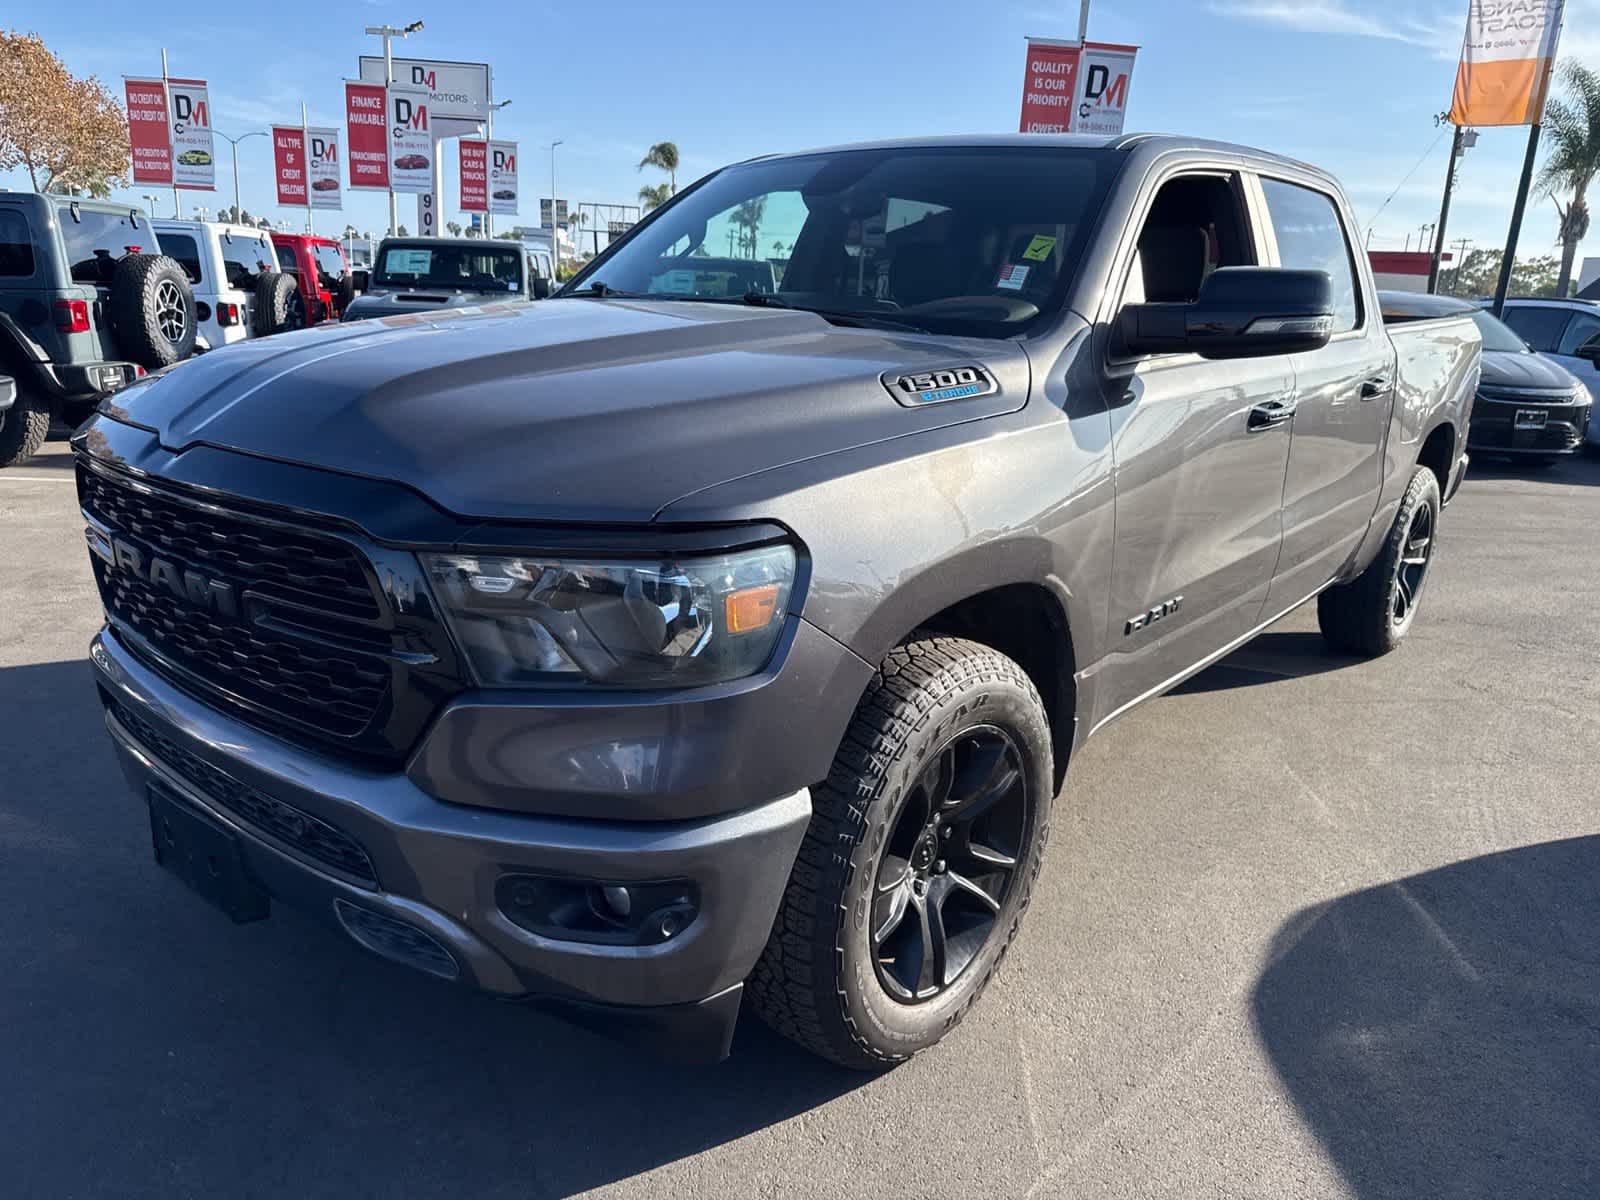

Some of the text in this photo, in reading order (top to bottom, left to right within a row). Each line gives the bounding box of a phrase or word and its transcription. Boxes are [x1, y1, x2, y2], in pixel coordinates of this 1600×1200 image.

[1031, 61, 1073, 74] QUALITY
[1034, 78, 1066, 90] IS OUR
[351, 96, 382, 109] FINANCE
[429, 92, 469, 104] MOTORS
[1027, 93, 1069, 107] PRIORITY
[349, 113, 385, 126] AVAILABLE
[1027, 122, 1064, 133] LOWEST
[277, 136, 302, 149] ALL TYPE
[286, 152, 295, 164] OF
[463, 159, 479, 169] CARS
[281, 168, 301, 179] CREDIT
[463, 171, 485, 181] TRUCKS
[279, 183, 305, 196] WELCOME
[896, 368, 978, 392] 1500
[113, 537, 236, 617] RAM
